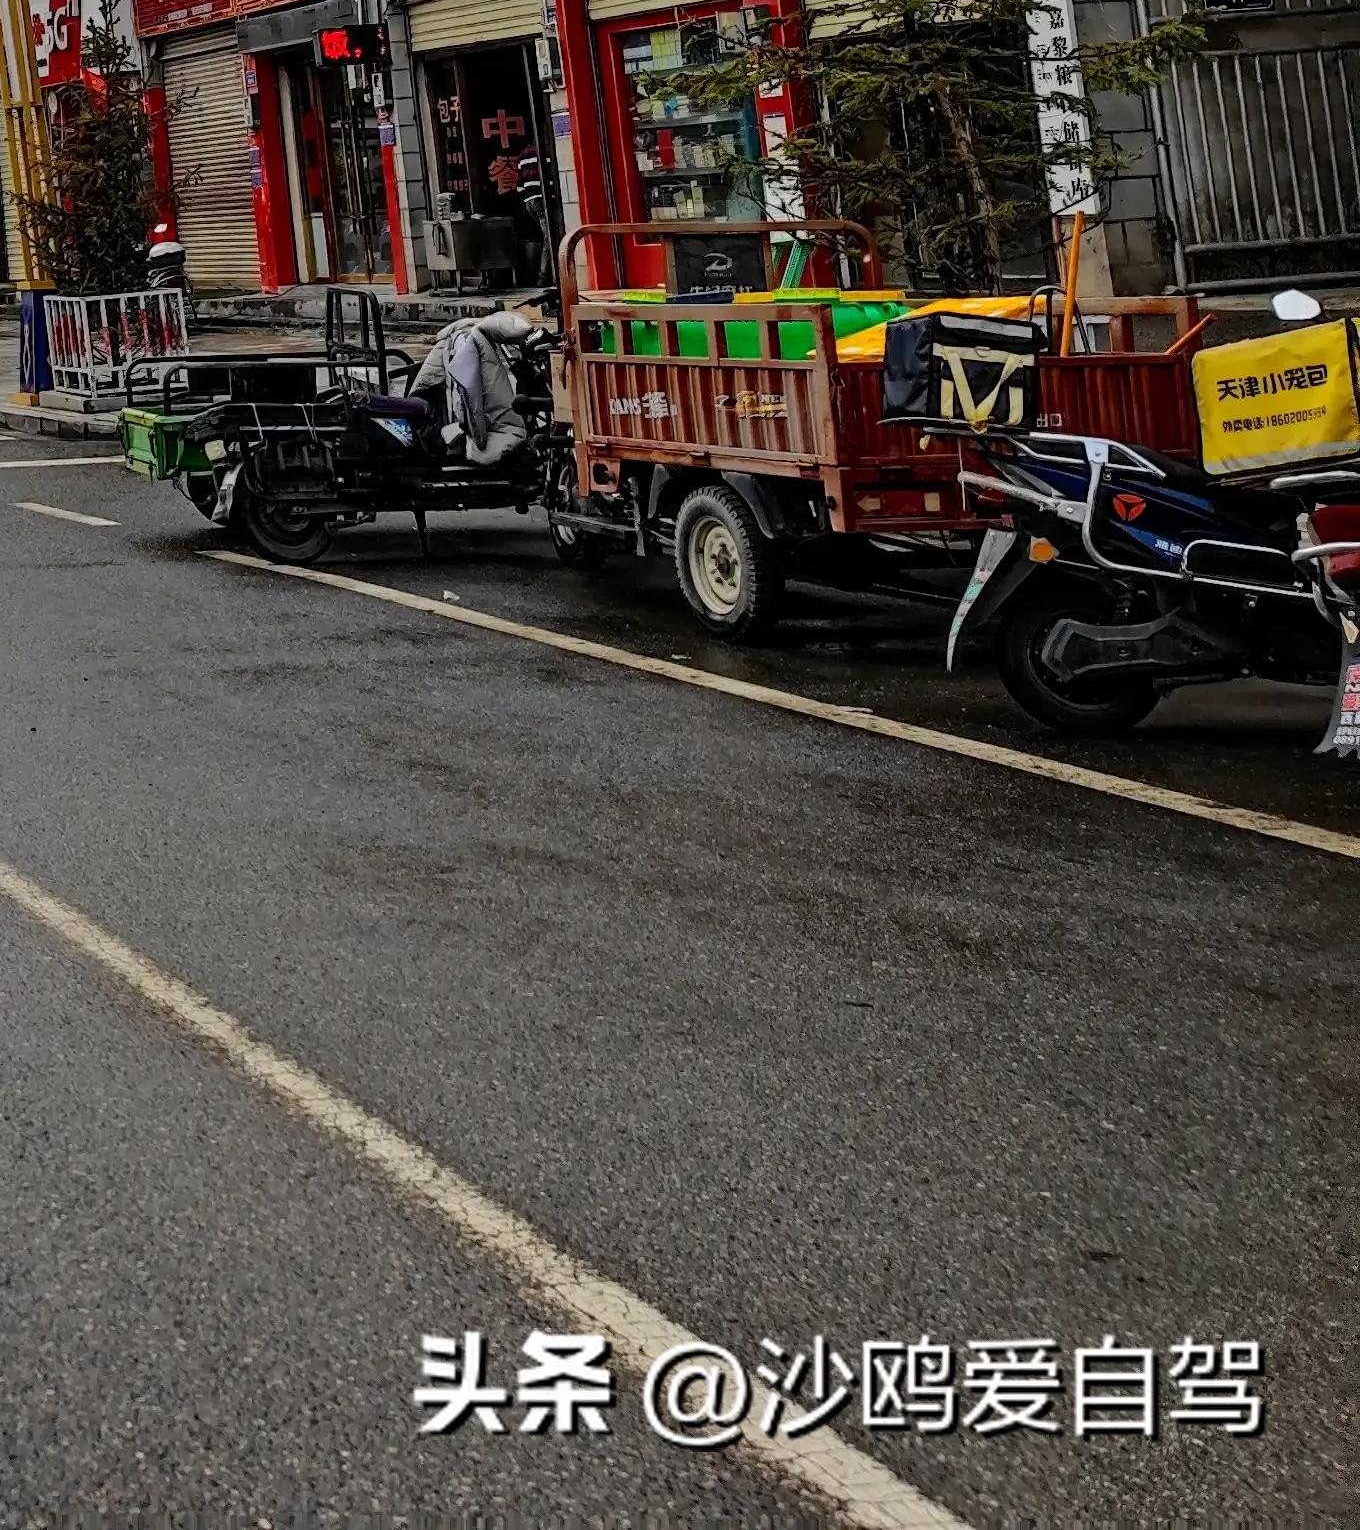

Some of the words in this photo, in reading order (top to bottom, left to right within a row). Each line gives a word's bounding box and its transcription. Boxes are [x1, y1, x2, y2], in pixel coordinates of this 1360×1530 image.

[1216, 363, 1329, 402] 天津小笼包
